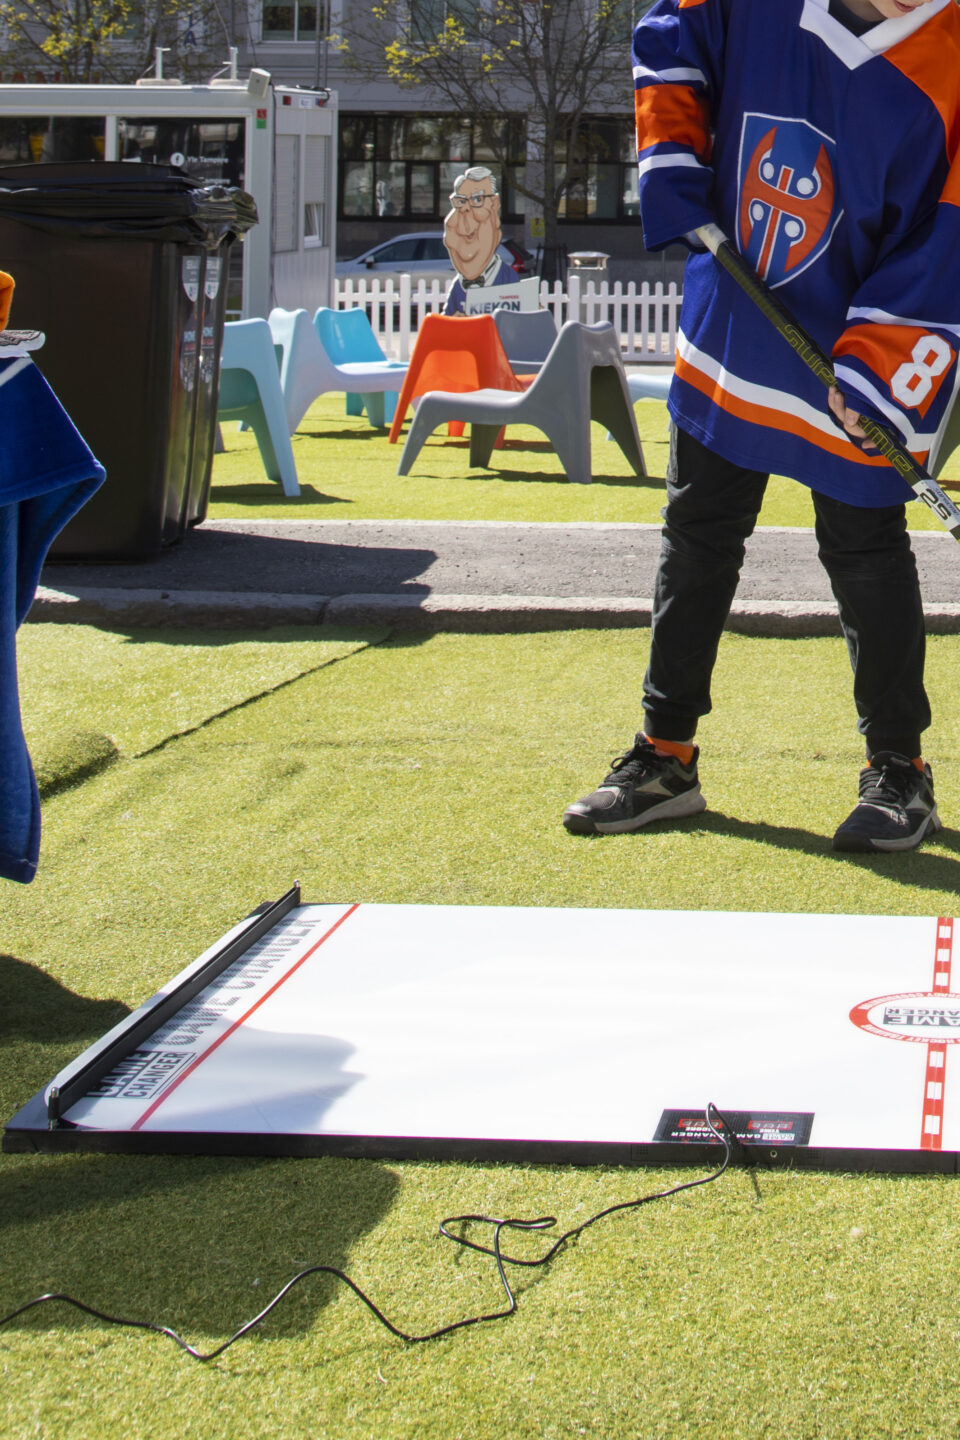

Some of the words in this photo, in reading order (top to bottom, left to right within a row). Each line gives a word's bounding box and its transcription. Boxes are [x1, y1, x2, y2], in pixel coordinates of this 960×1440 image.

[470, 301, 520, 314] KIEKON
[890, 334, 951, 407] 8
[122, 1052, 187, 1098] CHANGER
